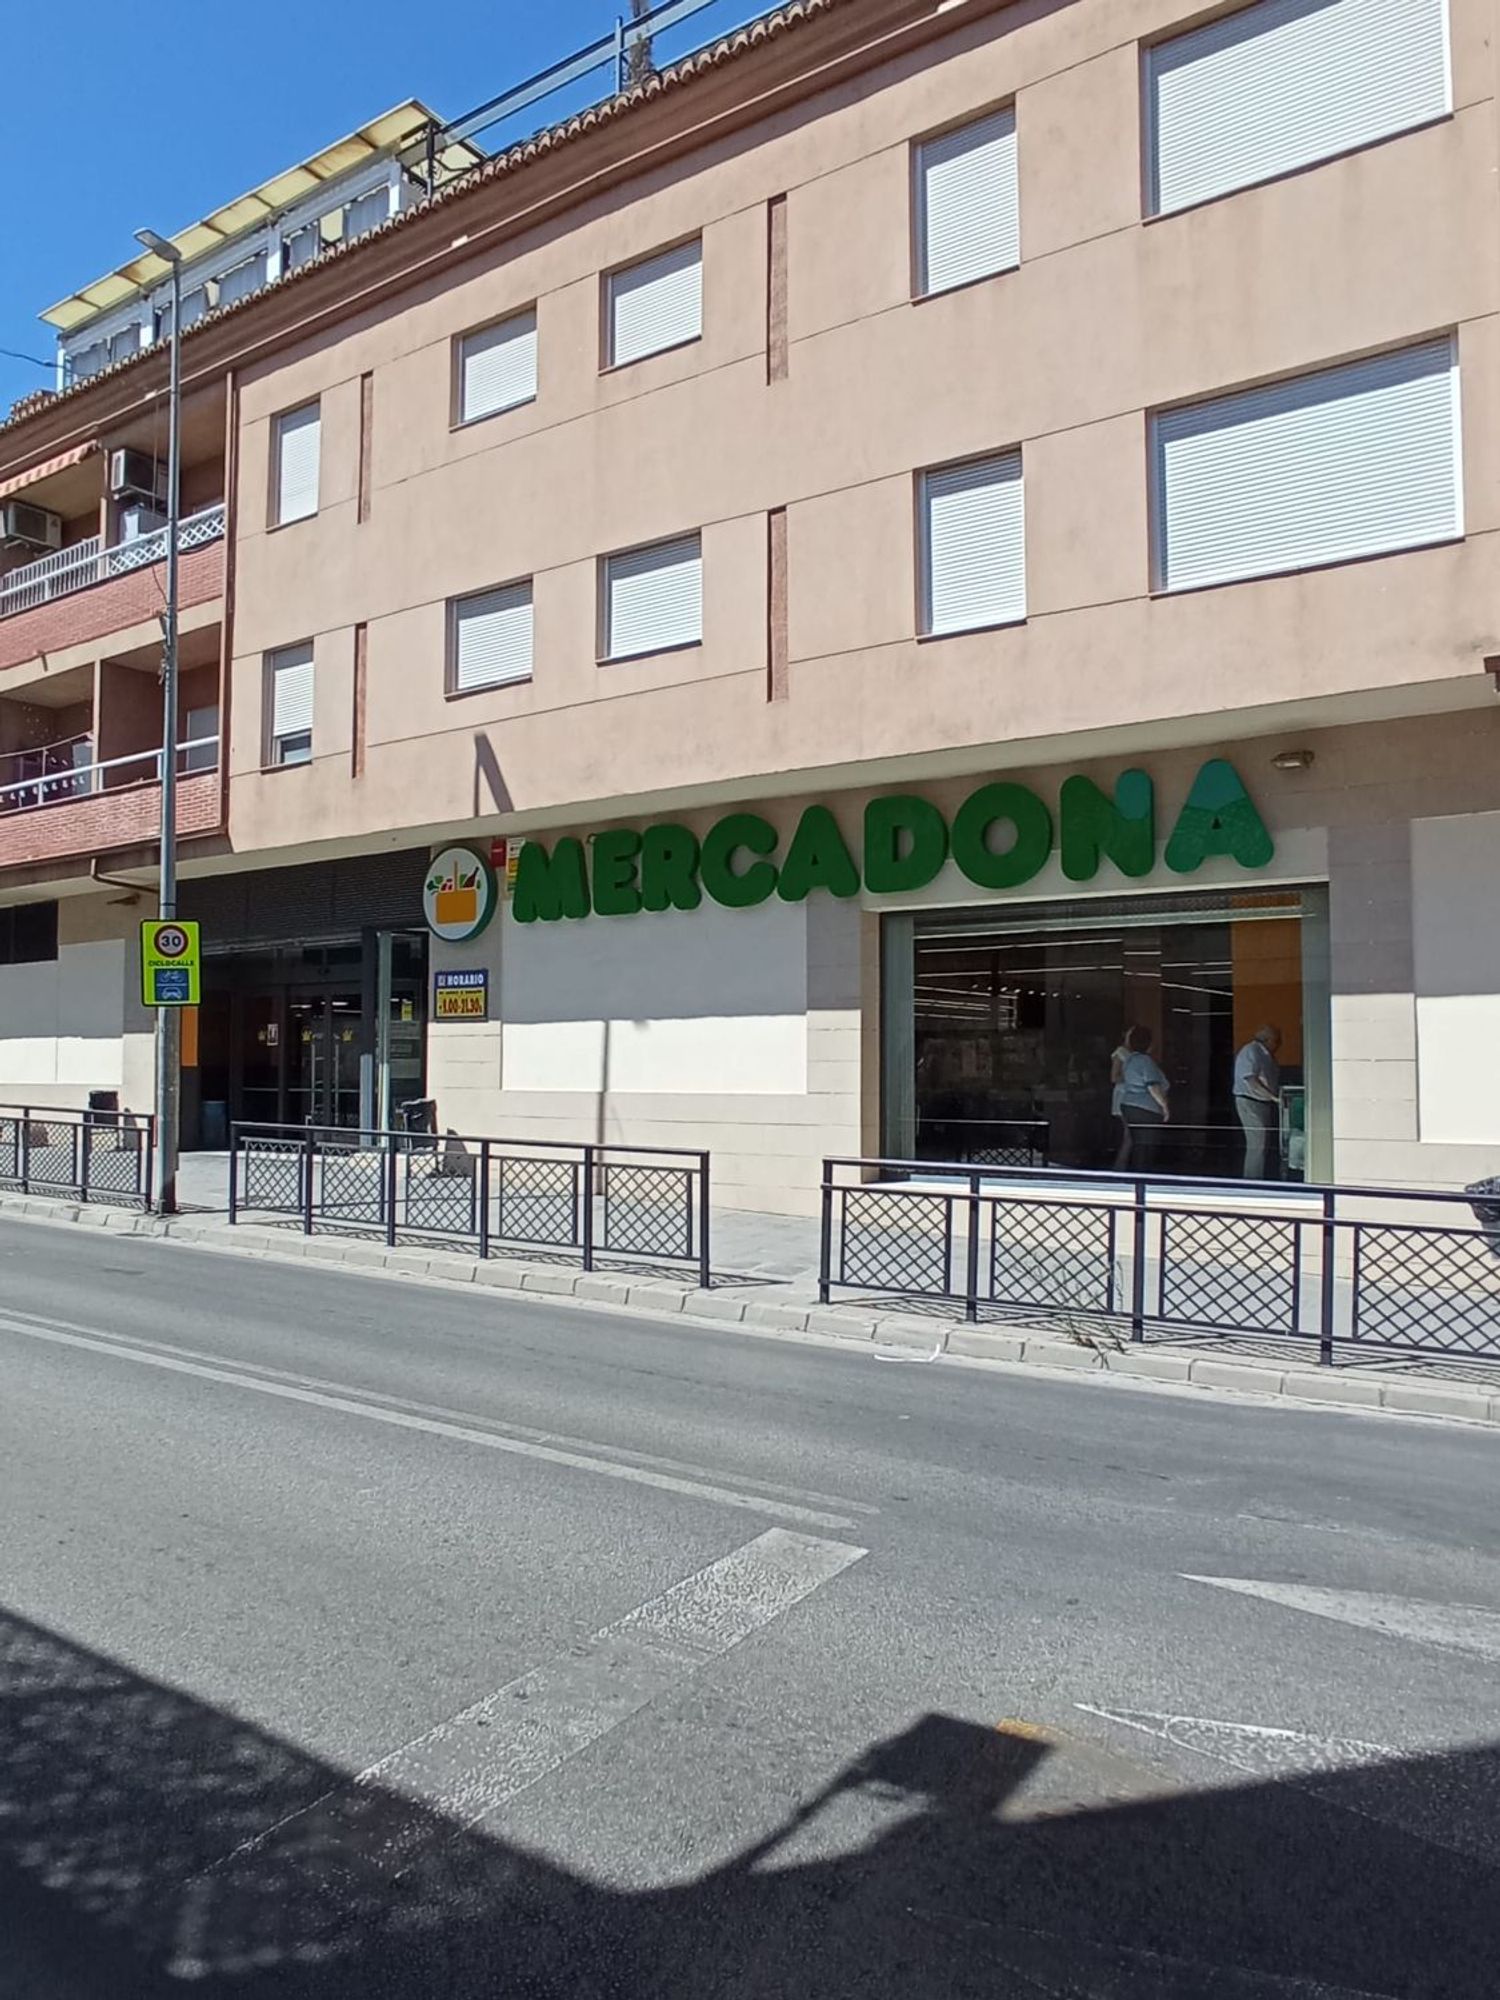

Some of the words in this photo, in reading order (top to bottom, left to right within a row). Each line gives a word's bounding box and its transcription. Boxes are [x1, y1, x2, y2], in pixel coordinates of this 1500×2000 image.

[513, 760, 1273, 922] MERCADONA
[161, 935, 181, 948] 30
[148, 959, 195, 967] CICLOCALLE
[447, 973, 484, 986] HORARIO
